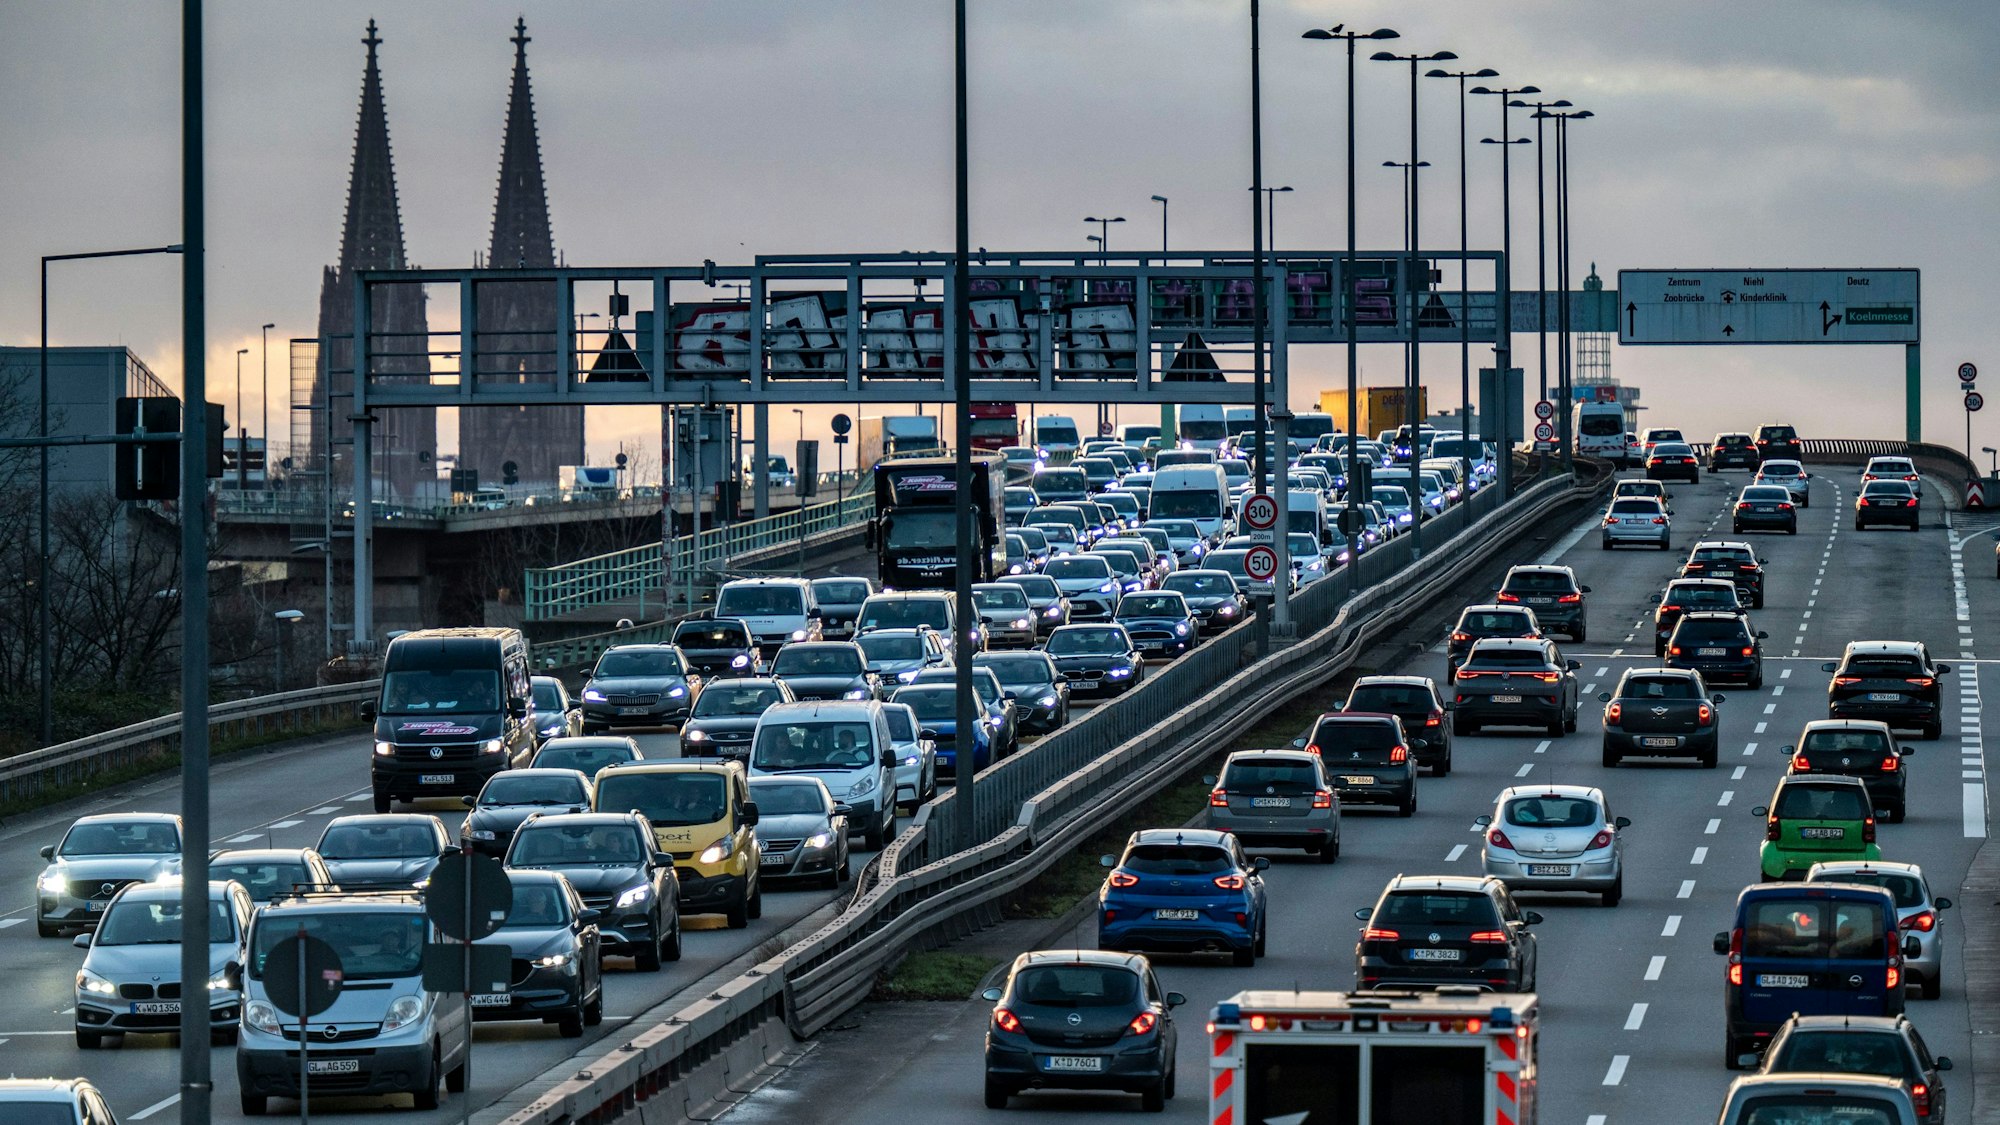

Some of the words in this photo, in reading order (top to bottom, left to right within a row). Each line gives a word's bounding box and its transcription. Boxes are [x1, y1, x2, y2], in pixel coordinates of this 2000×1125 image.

[1668, 277, 1701, 287] Zentrum
[1743, 277, 1764, 287] Niehl
[1847, 277, 1870, 287] Deutz
[1664, 292, 1705, 303] Zoobrücke
[1740, 292, 1787, 303] Kinderklinik
[1849, 311, 1909, 321] Koelnmesse
[1962, 368, 1973, 377] 50
[1968, 398, 1980, 407] 30t
[1538, 406, 1551, 414] 30t
[1539, 428, 1550, 437] 50
[1250, 505, 1272, 519] 30t
[1252, 556, 1271, 571] 50
[1806, 829, 1815, 837] GL
[770, 855, 782, 864] 511
[1181, 910, 1195, 918] 913
[1414, 951, 1420, 959] K
[1426, 951, 1435, 959] PK
[1438, 951, 1458, 959] 3823
[1761, 975, 1770, 985] GL
[1788, 975, 1807, 985] 1944
[482, 995, 493, 1004] WG
[494, 995, 509, 1003] 444
[136, 1003, 141, 1012] K
[147, 1003, 158, 1012] WQ
[159, 1002, 180, 1012] 1356
[309, 1062, 321, 1071] GL
[328, 1061, 339, 1071] AG
[340, 1061, 357, 1071] 559
[1054, 1058, 1060, 1068] K
[1066, 1058, 1072, 1067] D
[1074, 1058, 1097, 1067] 7601
